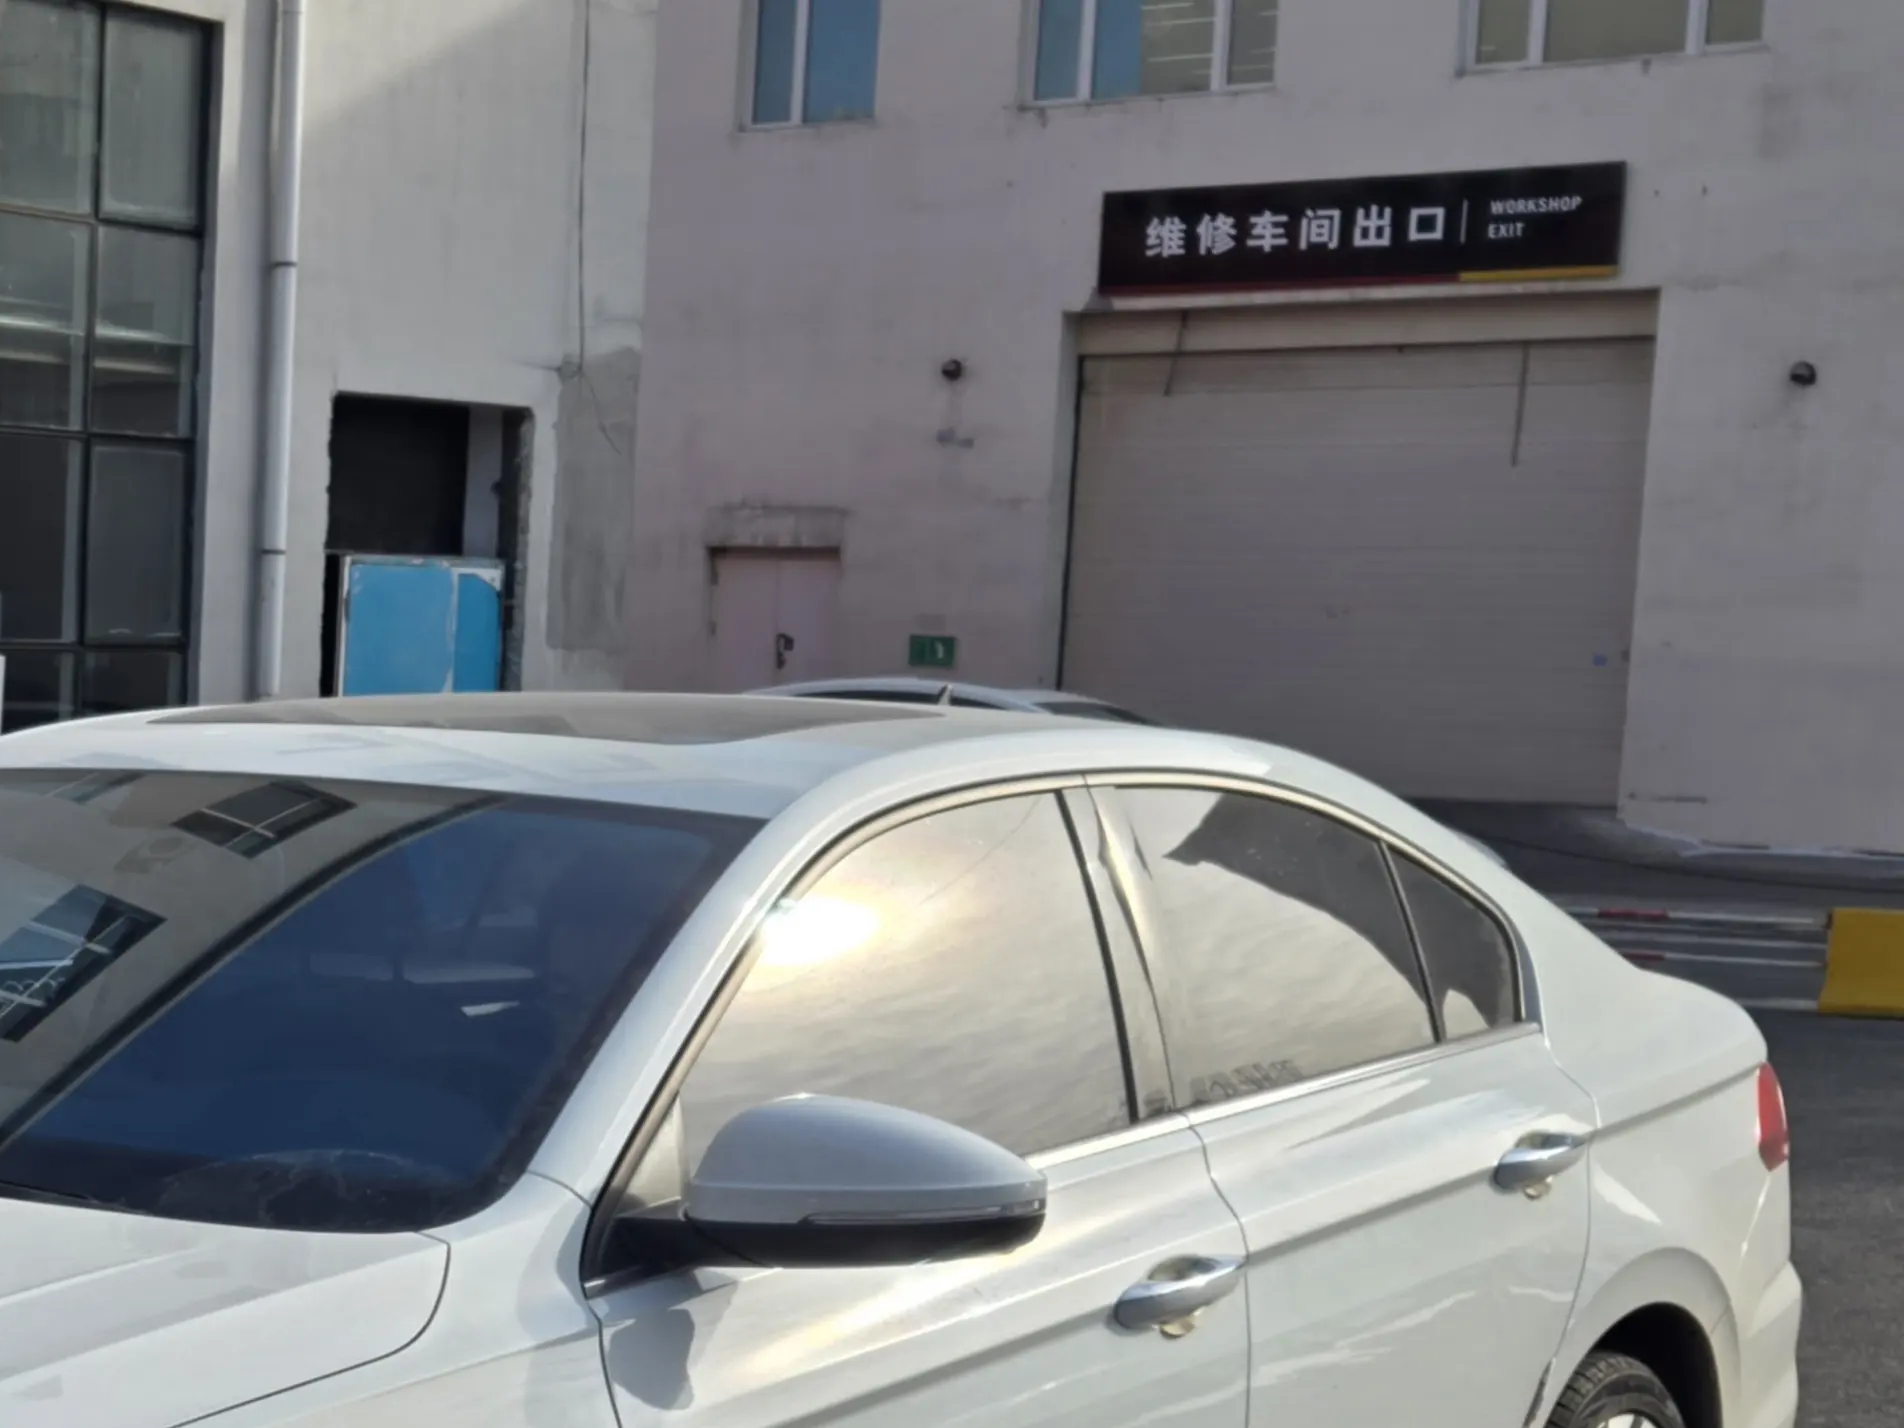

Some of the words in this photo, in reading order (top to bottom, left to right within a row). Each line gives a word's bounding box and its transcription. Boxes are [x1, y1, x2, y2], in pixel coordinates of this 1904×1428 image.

[1490, 195, 1582, 215] WORKSHOP
[1145, 203, 1447, 257] 维修车间出口
[1488, 222, 1525, 239] EXIT
